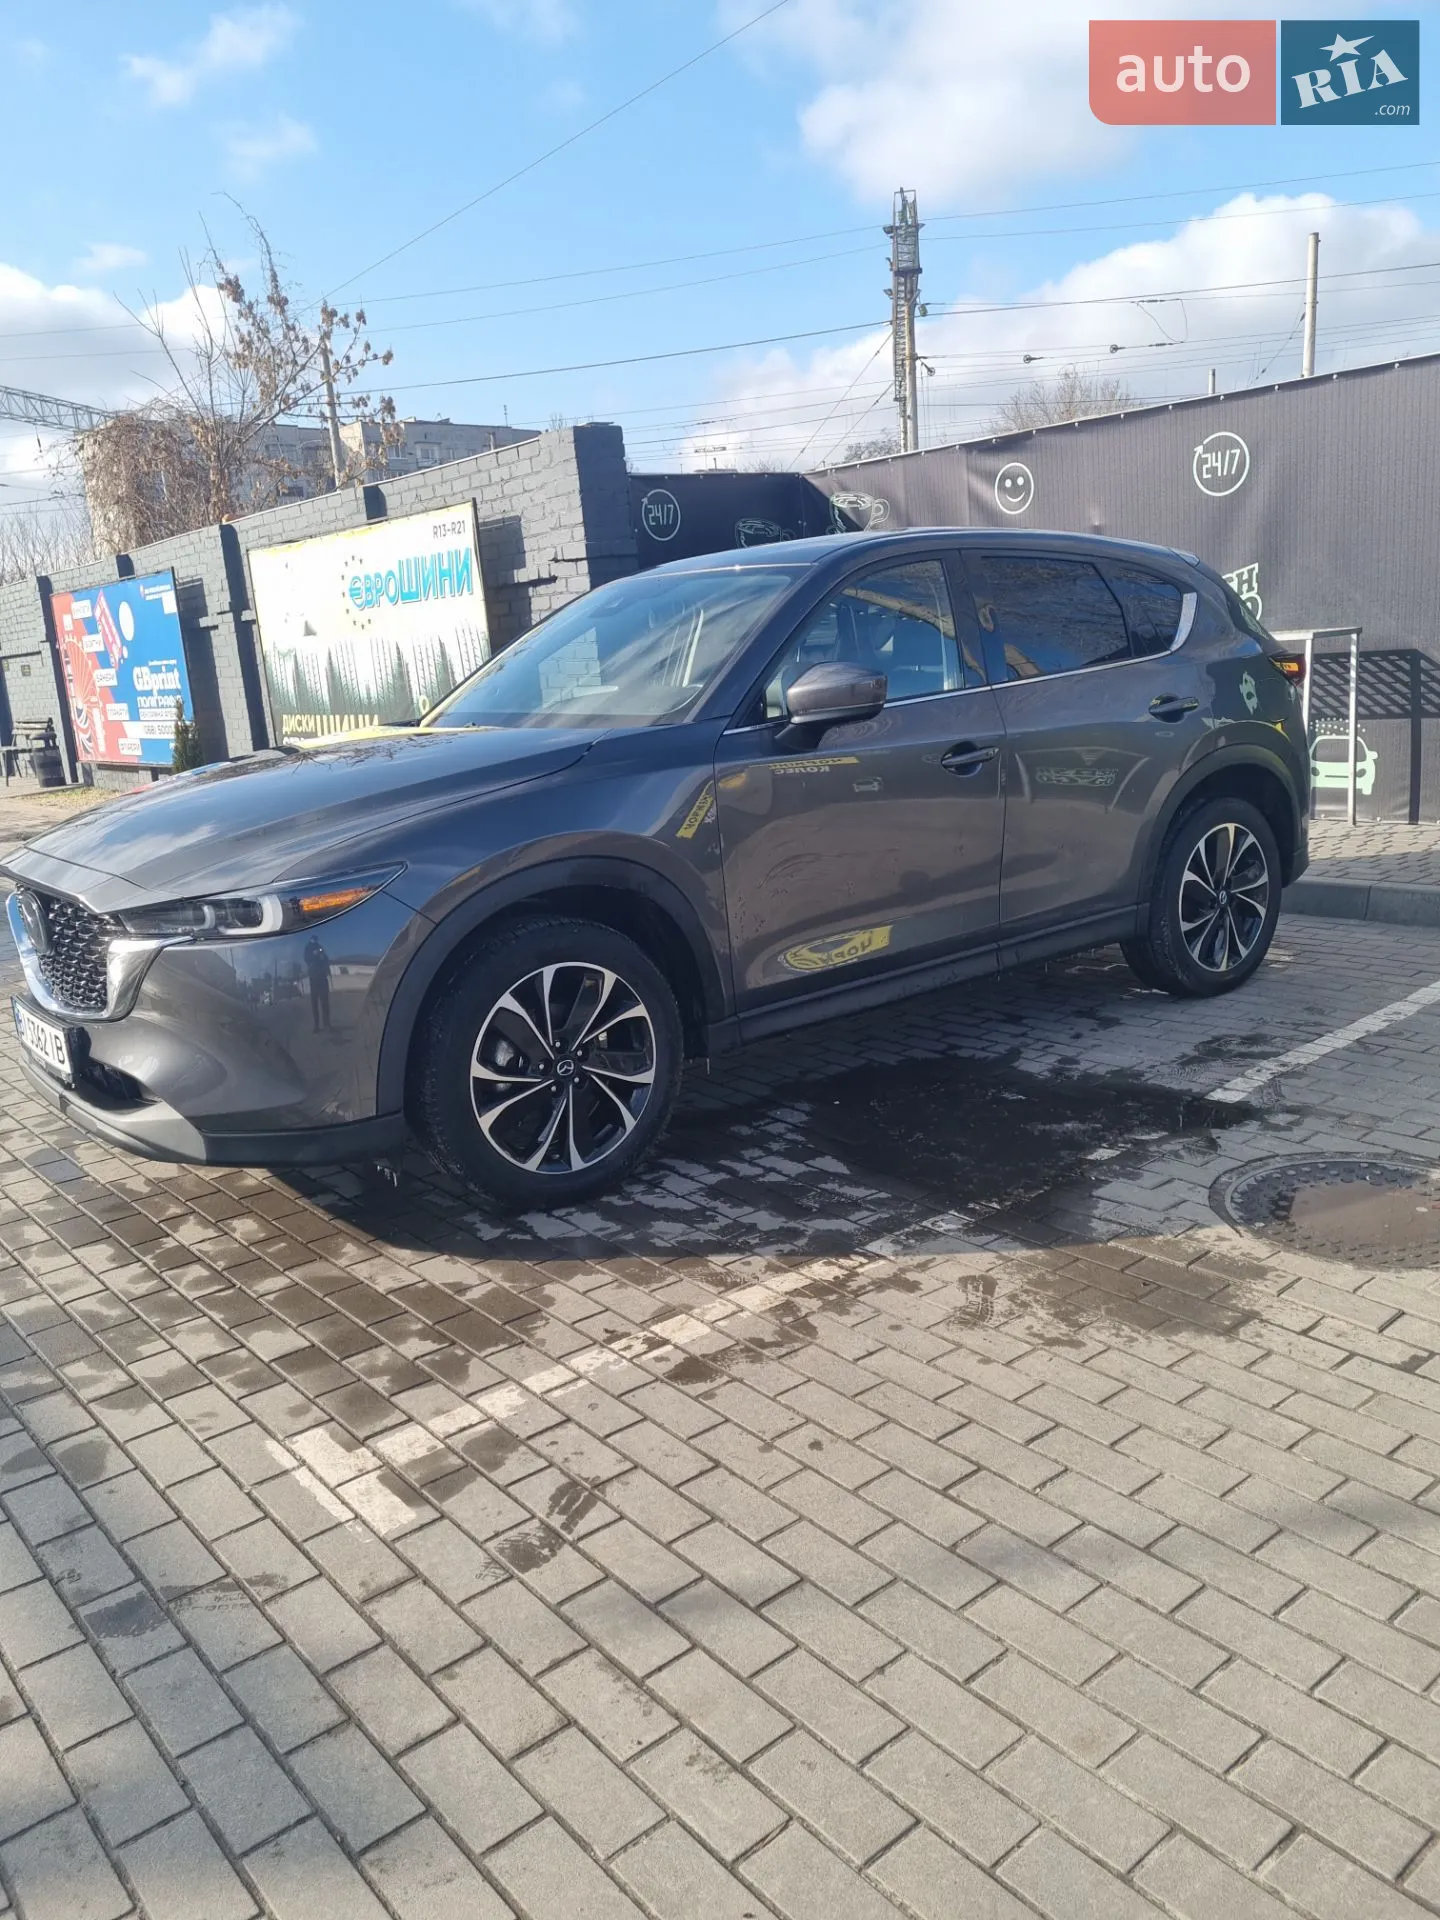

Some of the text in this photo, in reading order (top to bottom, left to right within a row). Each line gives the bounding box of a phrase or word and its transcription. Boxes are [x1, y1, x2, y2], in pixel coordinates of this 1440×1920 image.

[1201, 449, 1240, 479] 24/7
[647, 504, 674, 526] 24/7
[433, 520, 466, 539] R13-R21
[282, 713, 316, 735] ДИСКИ
